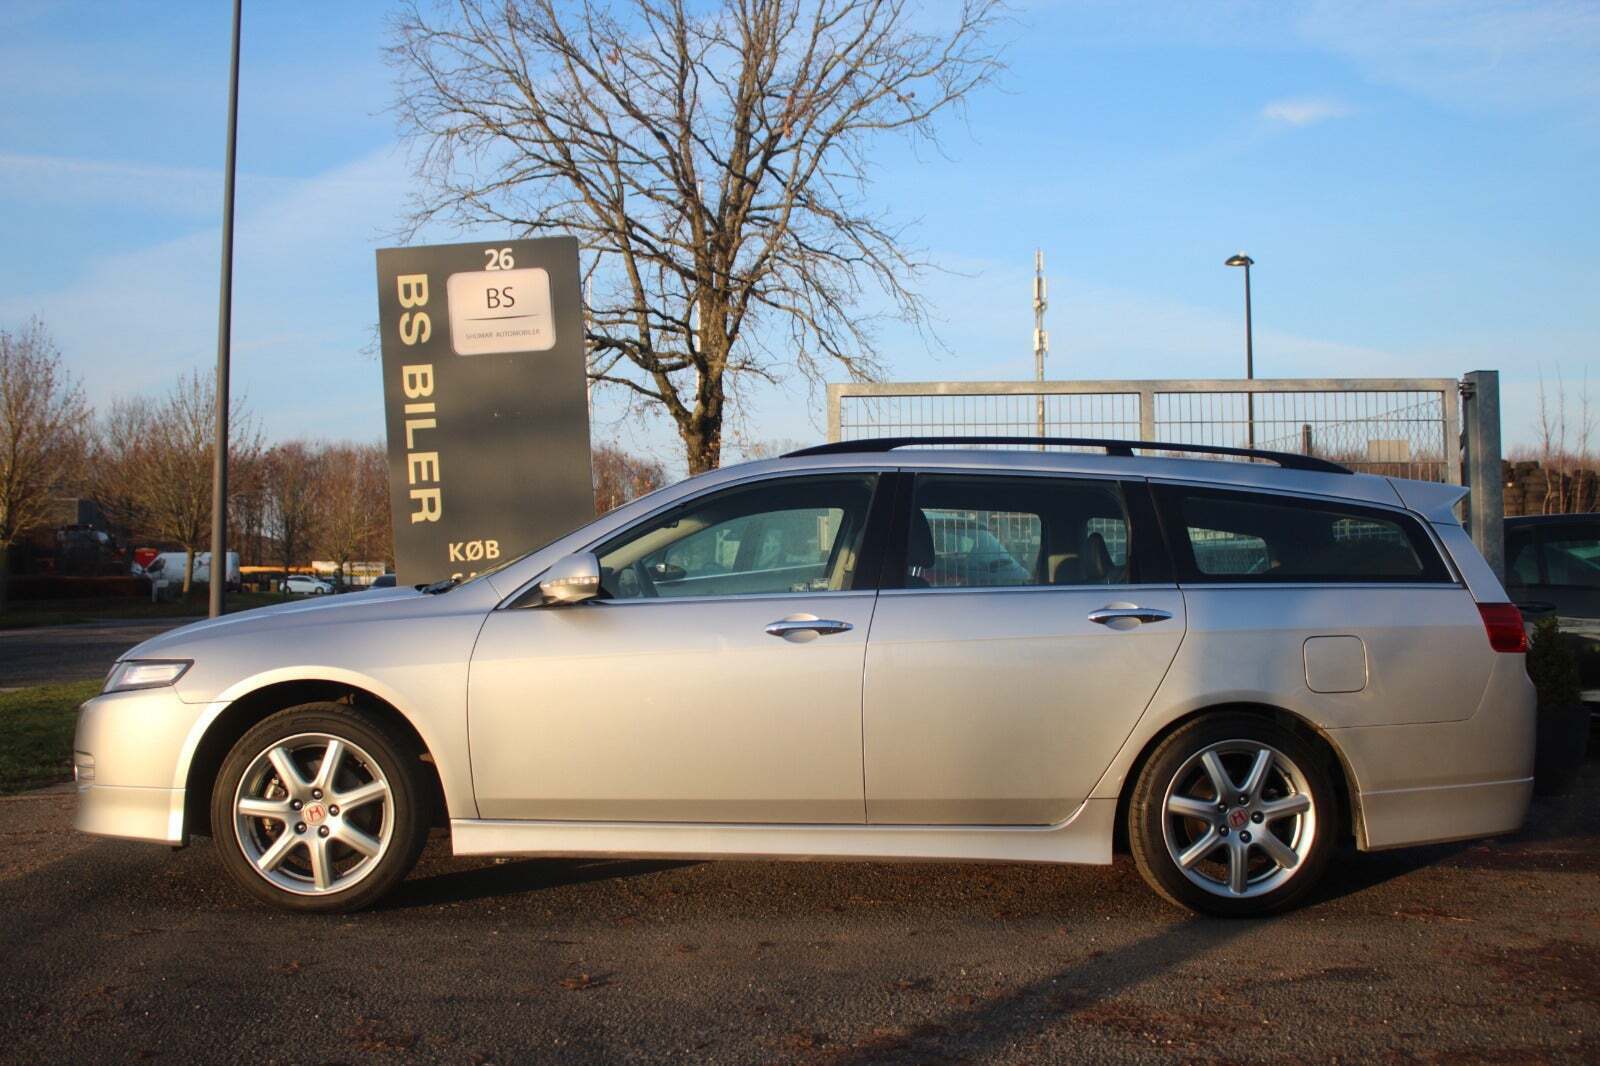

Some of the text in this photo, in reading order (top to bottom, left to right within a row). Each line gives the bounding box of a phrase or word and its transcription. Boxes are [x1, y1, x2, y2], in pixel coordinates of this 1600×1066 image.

[485, 247, 515, 271] 26
[486, 286, 515, 309] BS
[397, 273, 442, 525] BS BILER
[449, 539, 500, 562] KØB
